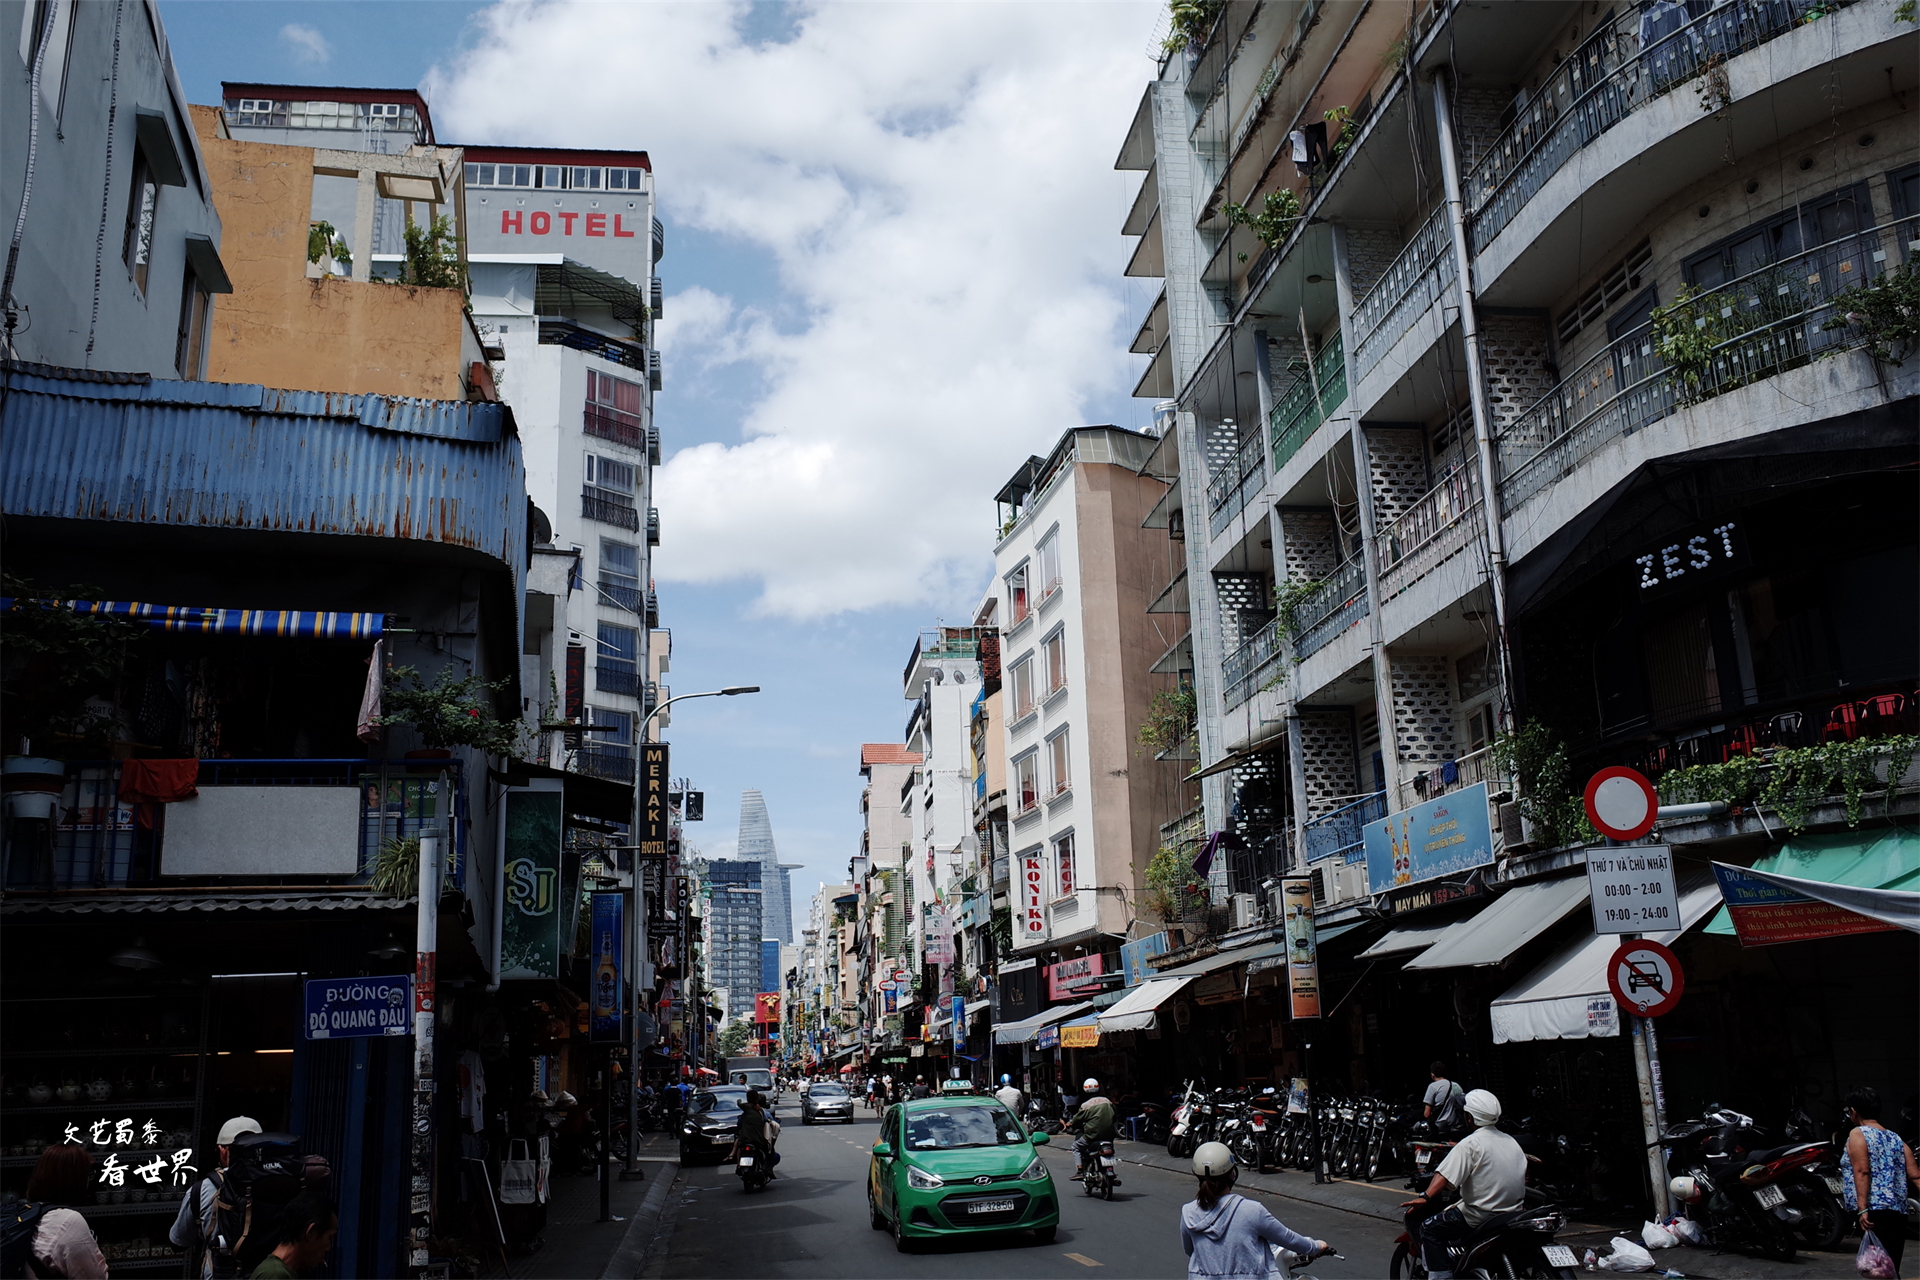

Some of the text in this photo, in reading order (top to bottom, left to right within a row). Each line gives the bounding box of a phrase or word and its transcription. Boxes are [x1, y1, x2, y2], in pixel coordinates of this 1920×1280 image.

[501, 210, 635, 238] HOTEL
[1635, 522, 1736, 589] ZEST
[646, 749, 663, 837] MERAKI
[641, 841, 666, 854] HOTEL
[1591, 854, 1668, 873] THỨ 7 VÀ CHỦ NHẬT
[1026, 859, 1042, 931] KONIKO
[1605, 883, 1631, 897] 00:00
[1641, 882, 1662, 894] 2:00
[1735, 887, 1757, 898] Thời
[1758, 887, 1777, 899] gian
[1395, 897, 1412, 913] MAY
[1412, 889, 1431, 909] MẮN
[1605, 908, 1630, 922] 19:00
[1642, 906, 1668, 919] 24:00
[1766, 921, 1786, 930] sinh
[326, 983, 389, 1003] ĐƯỜNG
[331, 1008, 376, 1030] QUANG
[945, 1080, 970, 1088] TAXI
